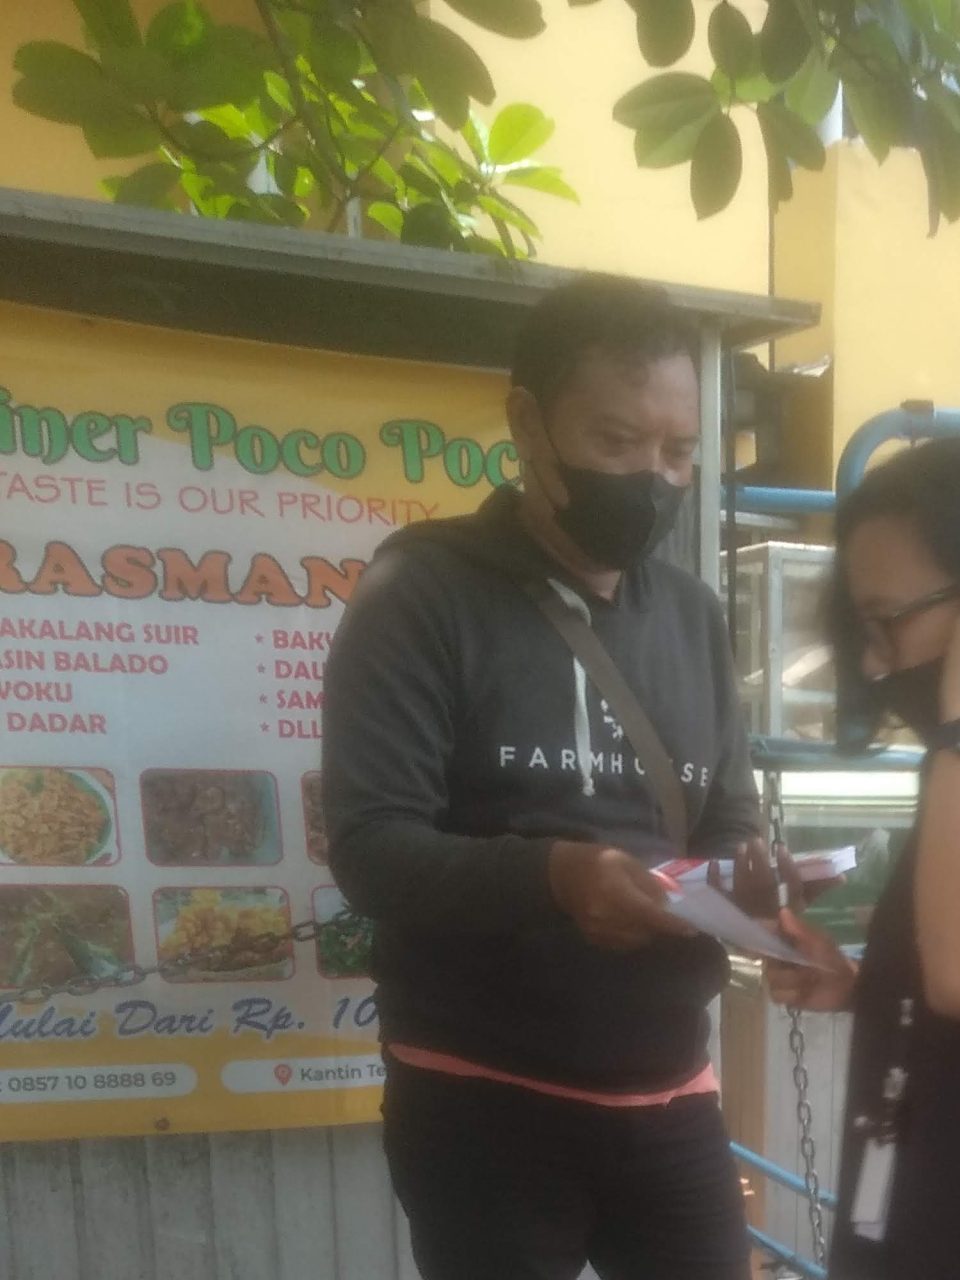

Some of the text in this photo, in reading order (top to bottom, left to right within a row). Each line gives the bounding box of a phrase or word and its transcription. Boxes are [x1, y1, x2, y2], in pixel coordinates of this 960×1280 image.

[166, 402, 366, 479] Poco
[379, 419, 524, 488] Poc
[125, 482, 161, 510] IS
[178, 486, 265, 518] OUR
[276, 491, 439, 526] PRIORITY
[142, 623, 199, 645] SUIR
[0, 650, 169, 675] SIN BALADO
[6, 712, 107, 734] DADAR
[500, 746, 709, 787] FARMHSE
[115, 1000, 214, 1036] Dari
[232, 997, 304, 1039] Rp.
[8, 1071, 176, 1093] 0857 10 8888 69
[300, 1063, 362, 1082] Kantin
